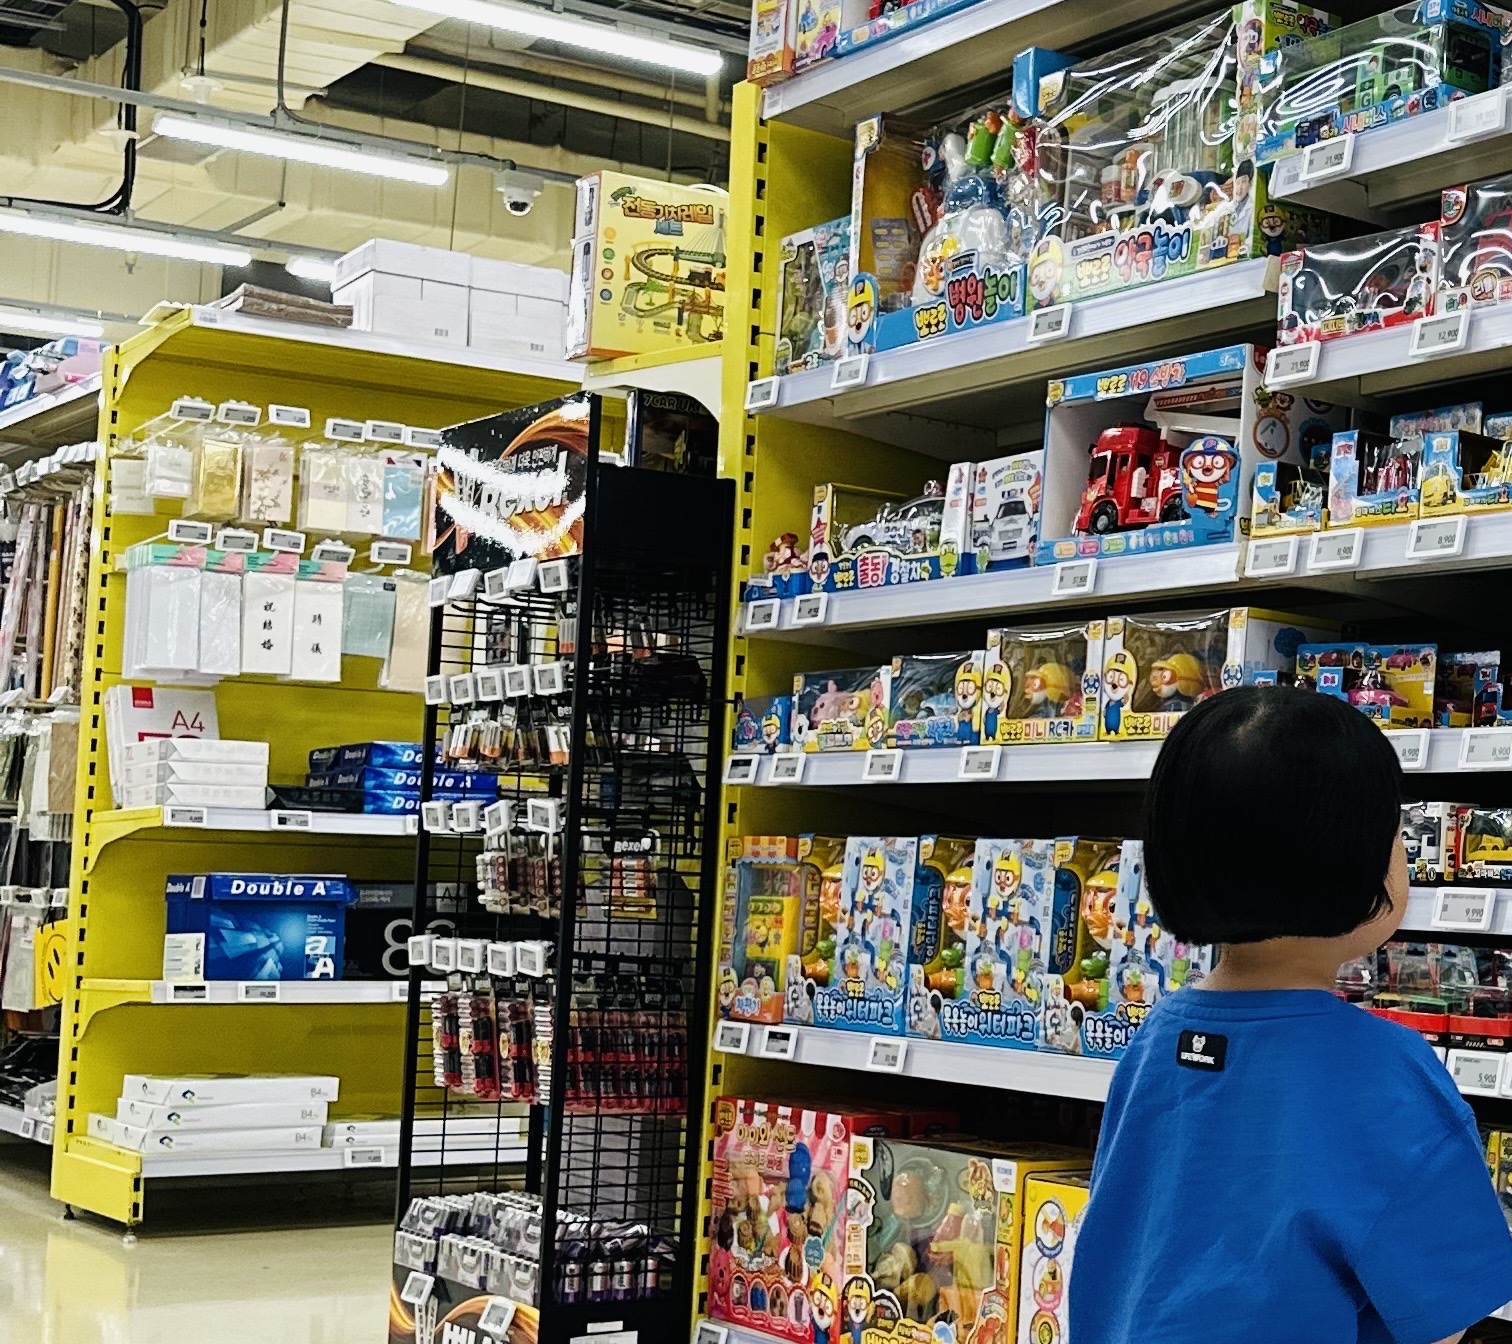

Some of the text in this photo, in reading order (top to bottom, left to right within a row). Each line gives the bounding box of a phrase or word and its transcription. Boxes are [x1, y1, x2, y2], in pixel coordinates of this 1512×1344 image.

[1343, 106, 1387, 132] 시내버스
[622, 194, 714, 225] 전동기차레일
[1076, 226, 1192, 287] 뽀로로 약국놀이
[914, 268, 1018, 338] 뽀로로 병원놀이
[1097, 362, 1185, 395] 뽀로로 119 소방차
[857, 555, 887, 587] 출동!
[172, 710, 206, 733] A4
[1023, 721, 1047, 739] 미니
[1048, 721, 1074, 739] RC카
[231, 879, 327, 897] Double A
